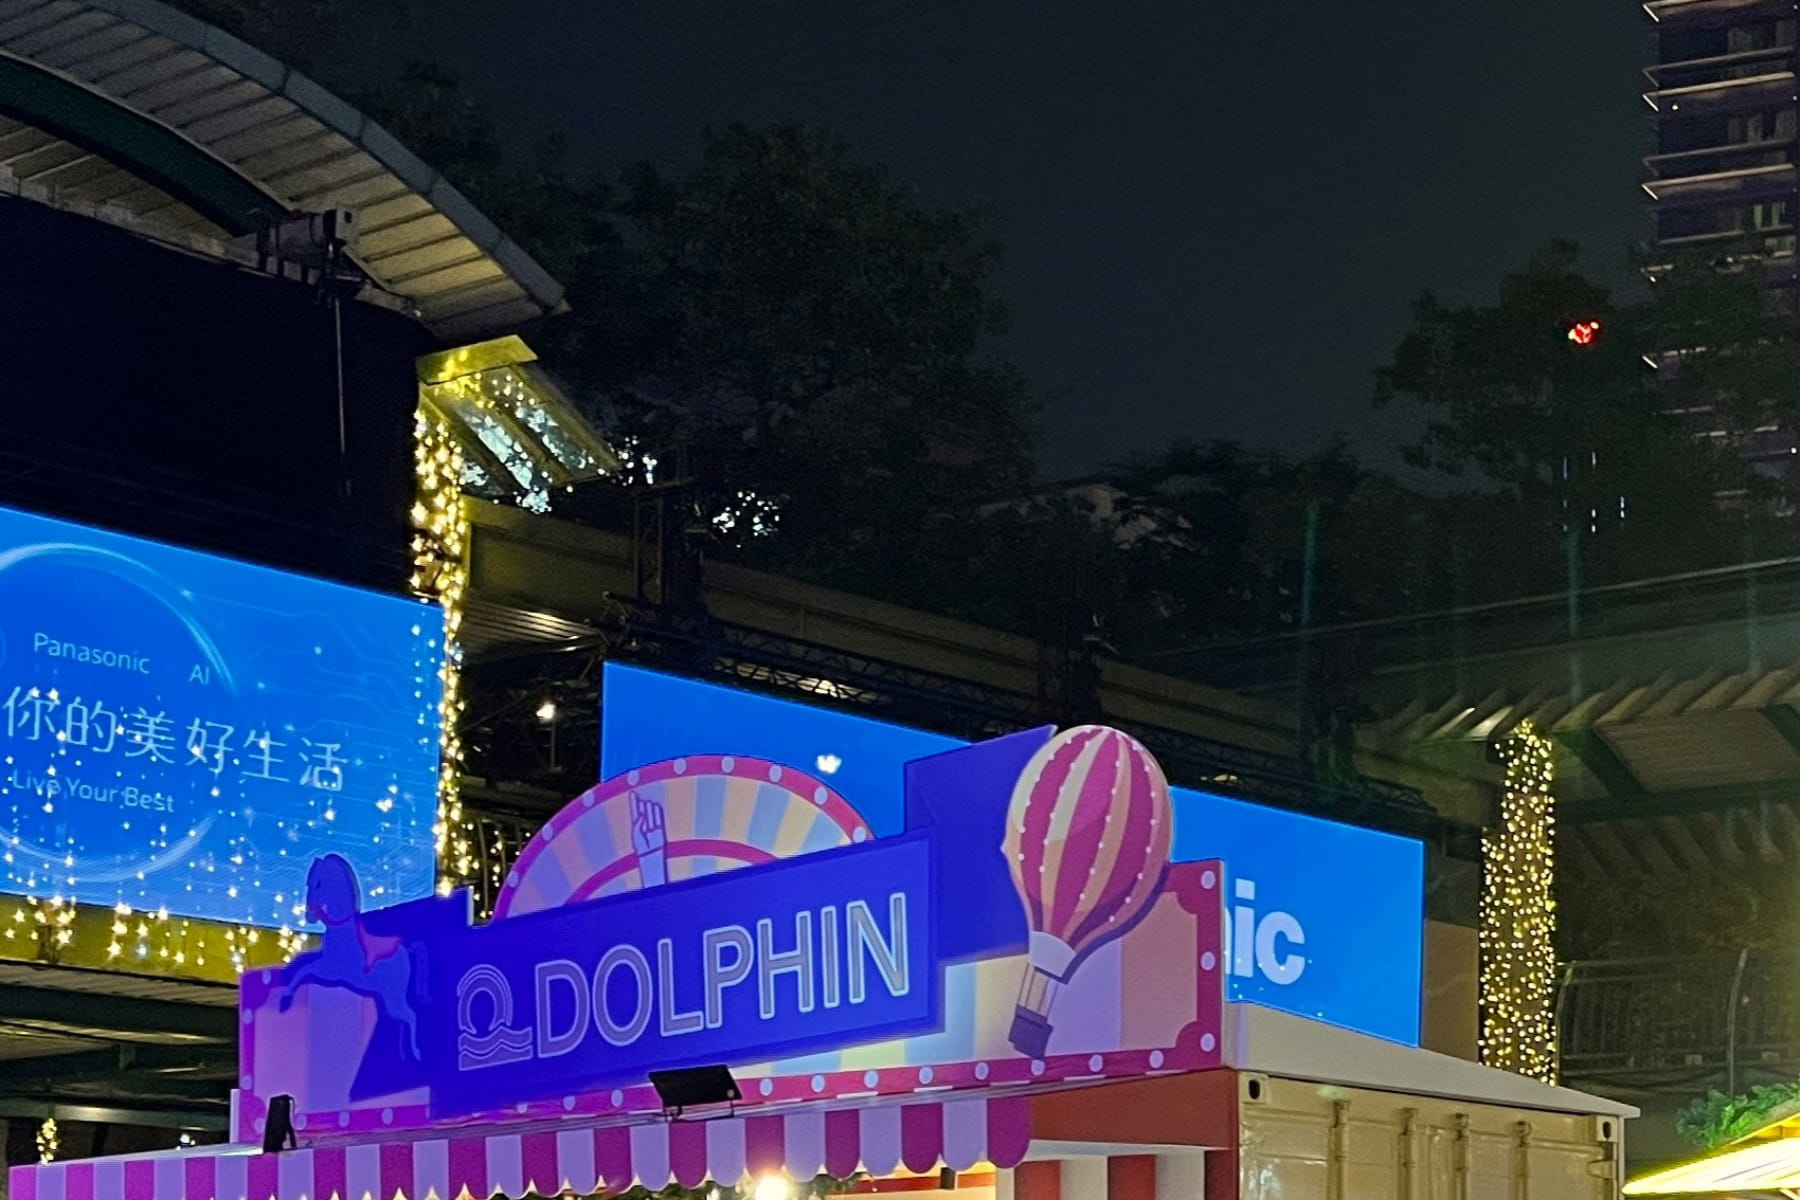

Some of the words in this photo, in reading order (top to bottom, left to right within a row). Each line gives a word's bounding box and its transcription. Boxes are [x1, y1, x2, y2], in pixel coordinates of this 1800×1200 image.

[33, 632, 151, 675] Panasonic
[188, 664, 211, 686] AI
[1, 685, 349, 792] 你的美好生活
[11, 768, 62, 796] Live
[65, 776, 117, 804] Your
[124, 786, 175, 813] Best
[534, 891, 911, 1059] DOLPHIN
[1225, 877, 1306, 986] ic
